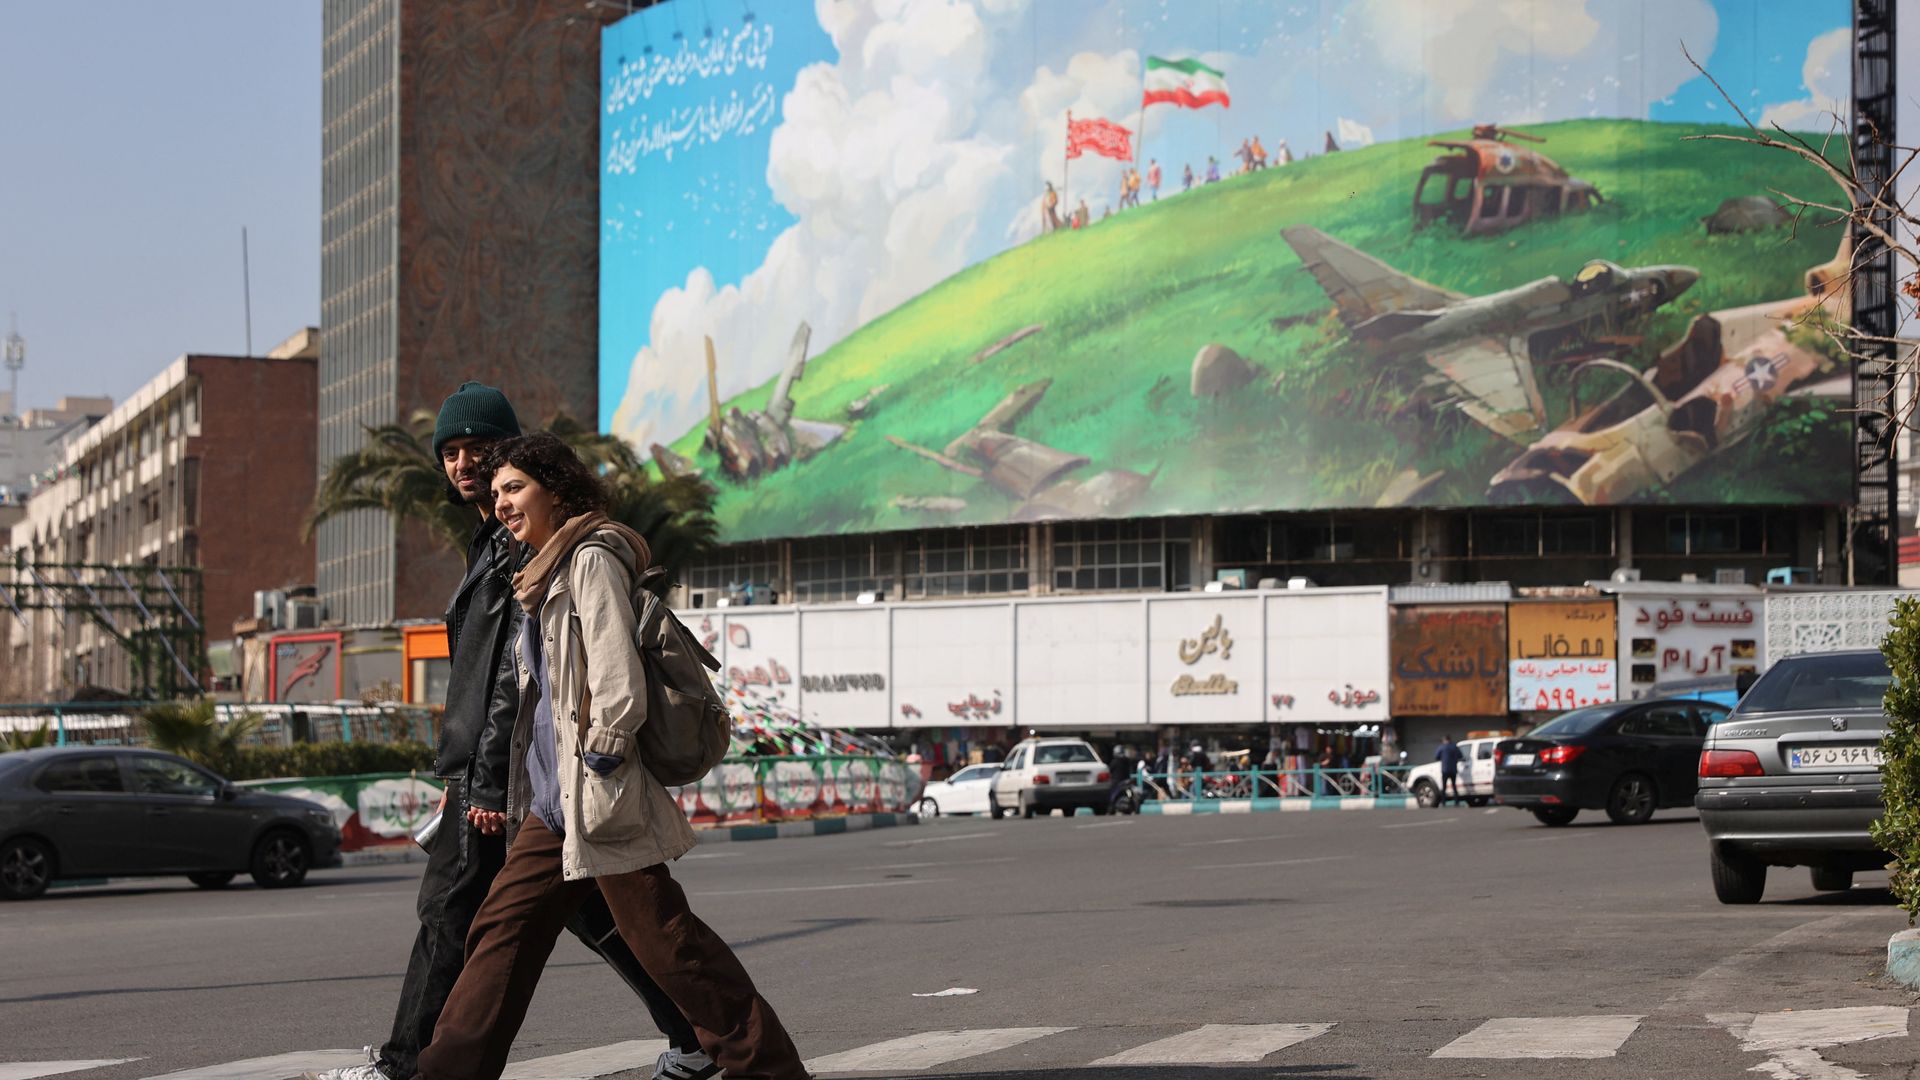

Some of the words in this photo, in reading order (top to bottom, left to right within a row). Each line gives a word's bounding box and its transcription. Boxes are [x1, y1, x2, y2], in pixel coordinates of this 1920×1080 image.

[1636, 599, 1684, 631] فود
[1692, 599, 1754, 625] فست
[1179, 613, 1233, 665] بالین
[1588, 663, 1608, 674] کلیه
[1663, 645, 1726, 675] آرام
[1328, 684, 1378, 706] موزه
[1802, 749, 1821, 764] ۵۶
[1825, 750, 1837, 763] ن
[1841, 748, 1870, 763] ۹۶۹
